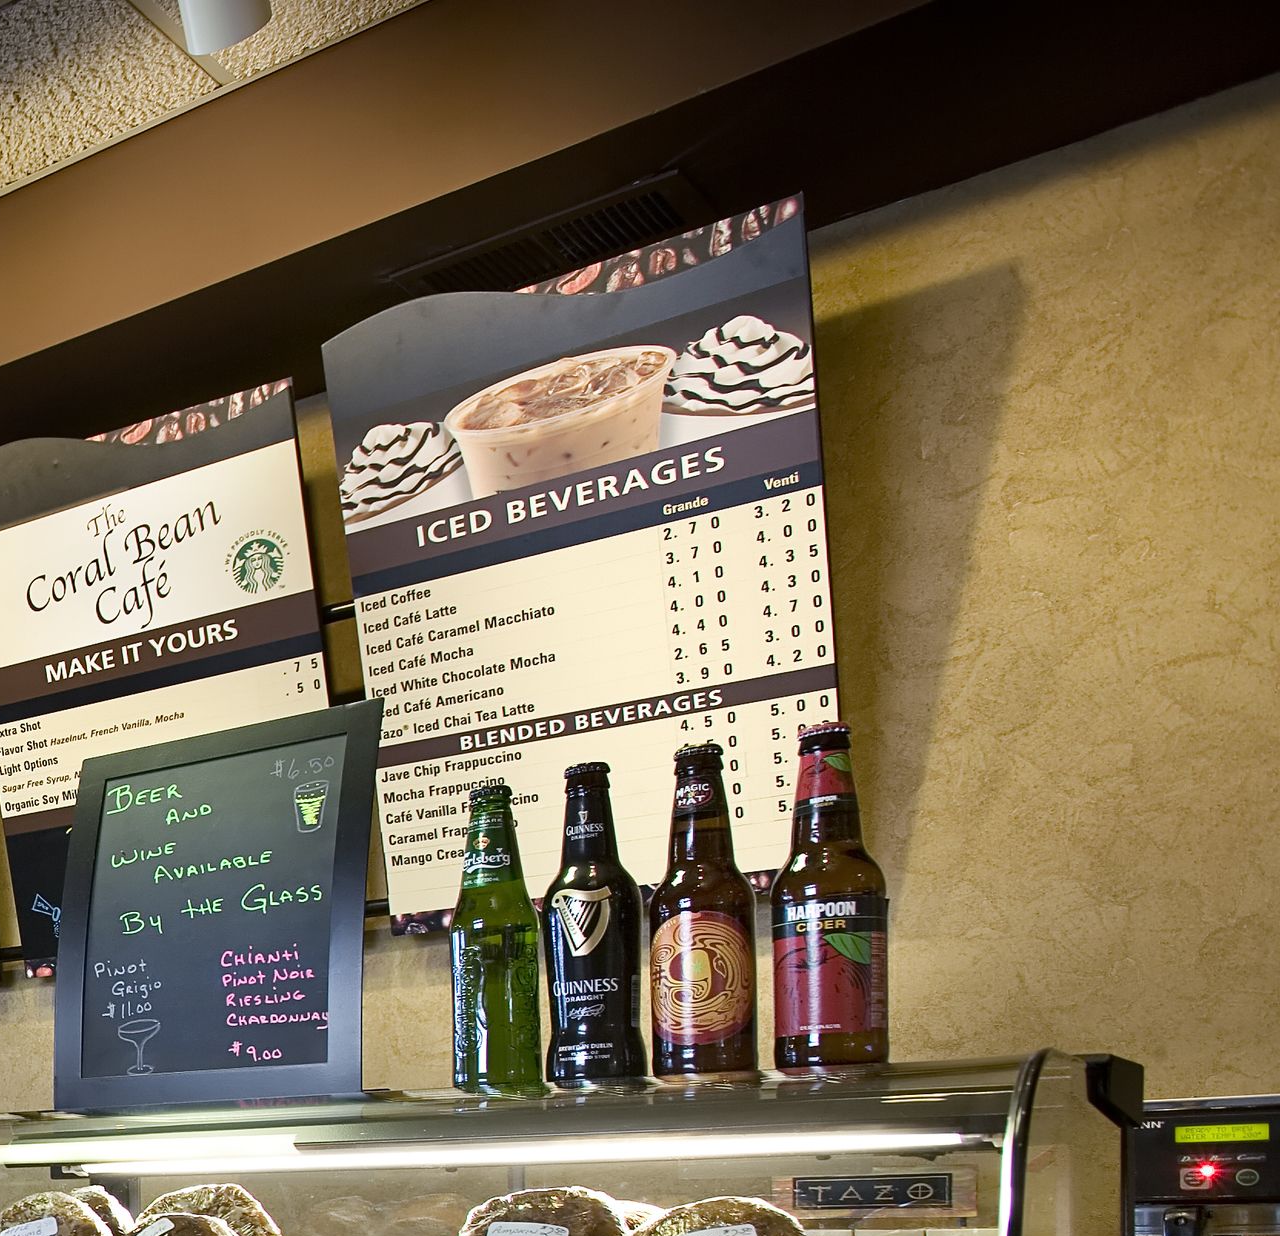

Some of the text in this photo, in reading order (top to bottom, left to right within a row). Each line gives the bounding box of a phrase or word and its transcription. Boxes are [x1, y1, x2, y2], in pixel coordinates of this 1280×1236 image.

[417, 446, 724, 546] ICED BEVERAGES
[663, 472, 799, 516] Grande Venti
[87, 503, 126, 538] The
[231, 530, 264, 550] PROUDLY
[26, 501, 222, 612] Coral Bean
[95, 557, 172, 629] Café
[360, 589, 430, 612] Iced Coffee
[363, 606, 456, 634] Iced Café Latte
[366, 606, 554, 655] Iced Café Caramel Macchiato
[45, 619, 237, 683] MAKE IT YOURS
[368, 647, 473, 677] Iced Café Mocha
[371, 652, 555, 699] Iced White Chocolate Mocha
[404, 687, 504, 713] Café Americano
[20, 721, 41, 733] Shot
[413, 704, 534, 734] Iced Chai Tea Latte
[460, 689, 722, 750] BLENDED BEVERAGES
[26, 739, 48, 751] Shot
[90, 725, 118, 737] French
[155, 712, 184, 723] Mocha
[0, 757, 58, 776] Light Options
[381, 751, 521, 782] Jave Chip Frappuccino
[2, 780, 43, 793] Sugar Free
[383, 789, 424, 804] Mocha
[676, 783, 709, 799] MAGIC
[5, 794, 59, 812] Organic Soy
[678, 795, 706, 805] HAT
[166, 804, 212, 825] AND
[386, 804, 456, 824] Café Vanilla
[388, 828, 437, 845] Caramel
[566, 822, 604, 836] GUINNESS
[153, 850, 272, 883] AVAILABLE
[391, 854, 432, 866] Mango
[788, 901, 856, 920] HARPOON
[796, 920, 846, 932] CIDER
[553, 978, 618, 996] GUINNESS
[808, 1182, 934, 1202] TAZO
